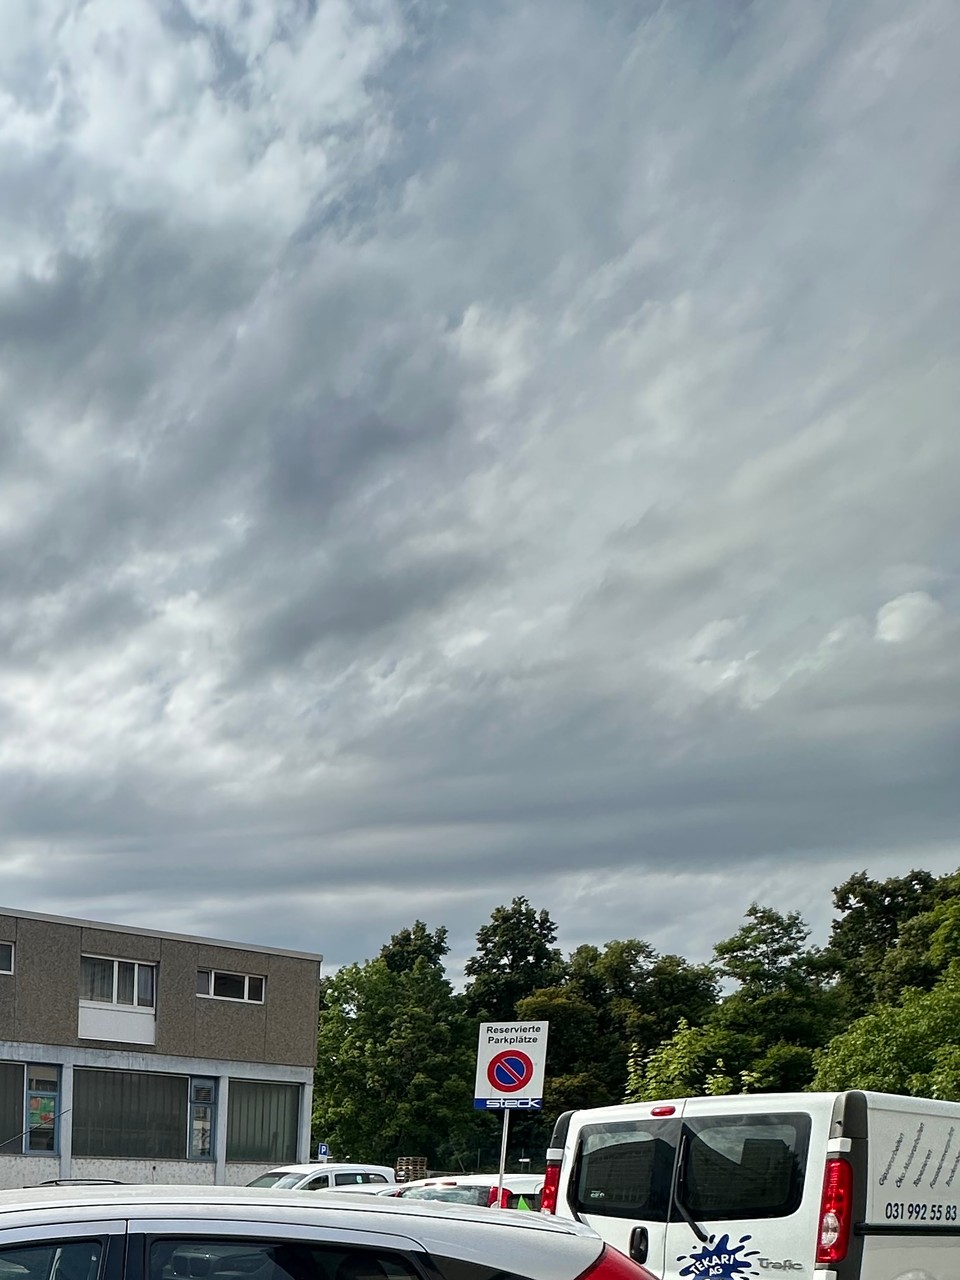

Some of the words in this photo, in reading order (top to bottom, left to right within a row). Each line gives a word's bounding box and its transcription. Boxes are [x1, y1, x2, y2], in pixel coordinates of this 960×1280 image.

[486, 1025, 541, 1034] Reservierte
[488, 1036, 538, 1045] Parkplätze
[486, 1097, 541, 1108] steck
[321, 1145, 327, 1155] P
[885, 1202, 904, 1219] 031
[907, 1203, 927, 1220] 992
[929, 1204, 943, 1220] 55
[945, 1204, 957, 1221] 83
[689, 1254, 735, 1275] TEKARI
[757, 1258, 804, 1271] Trafic
[708, 1266, 723, 1277] AG
